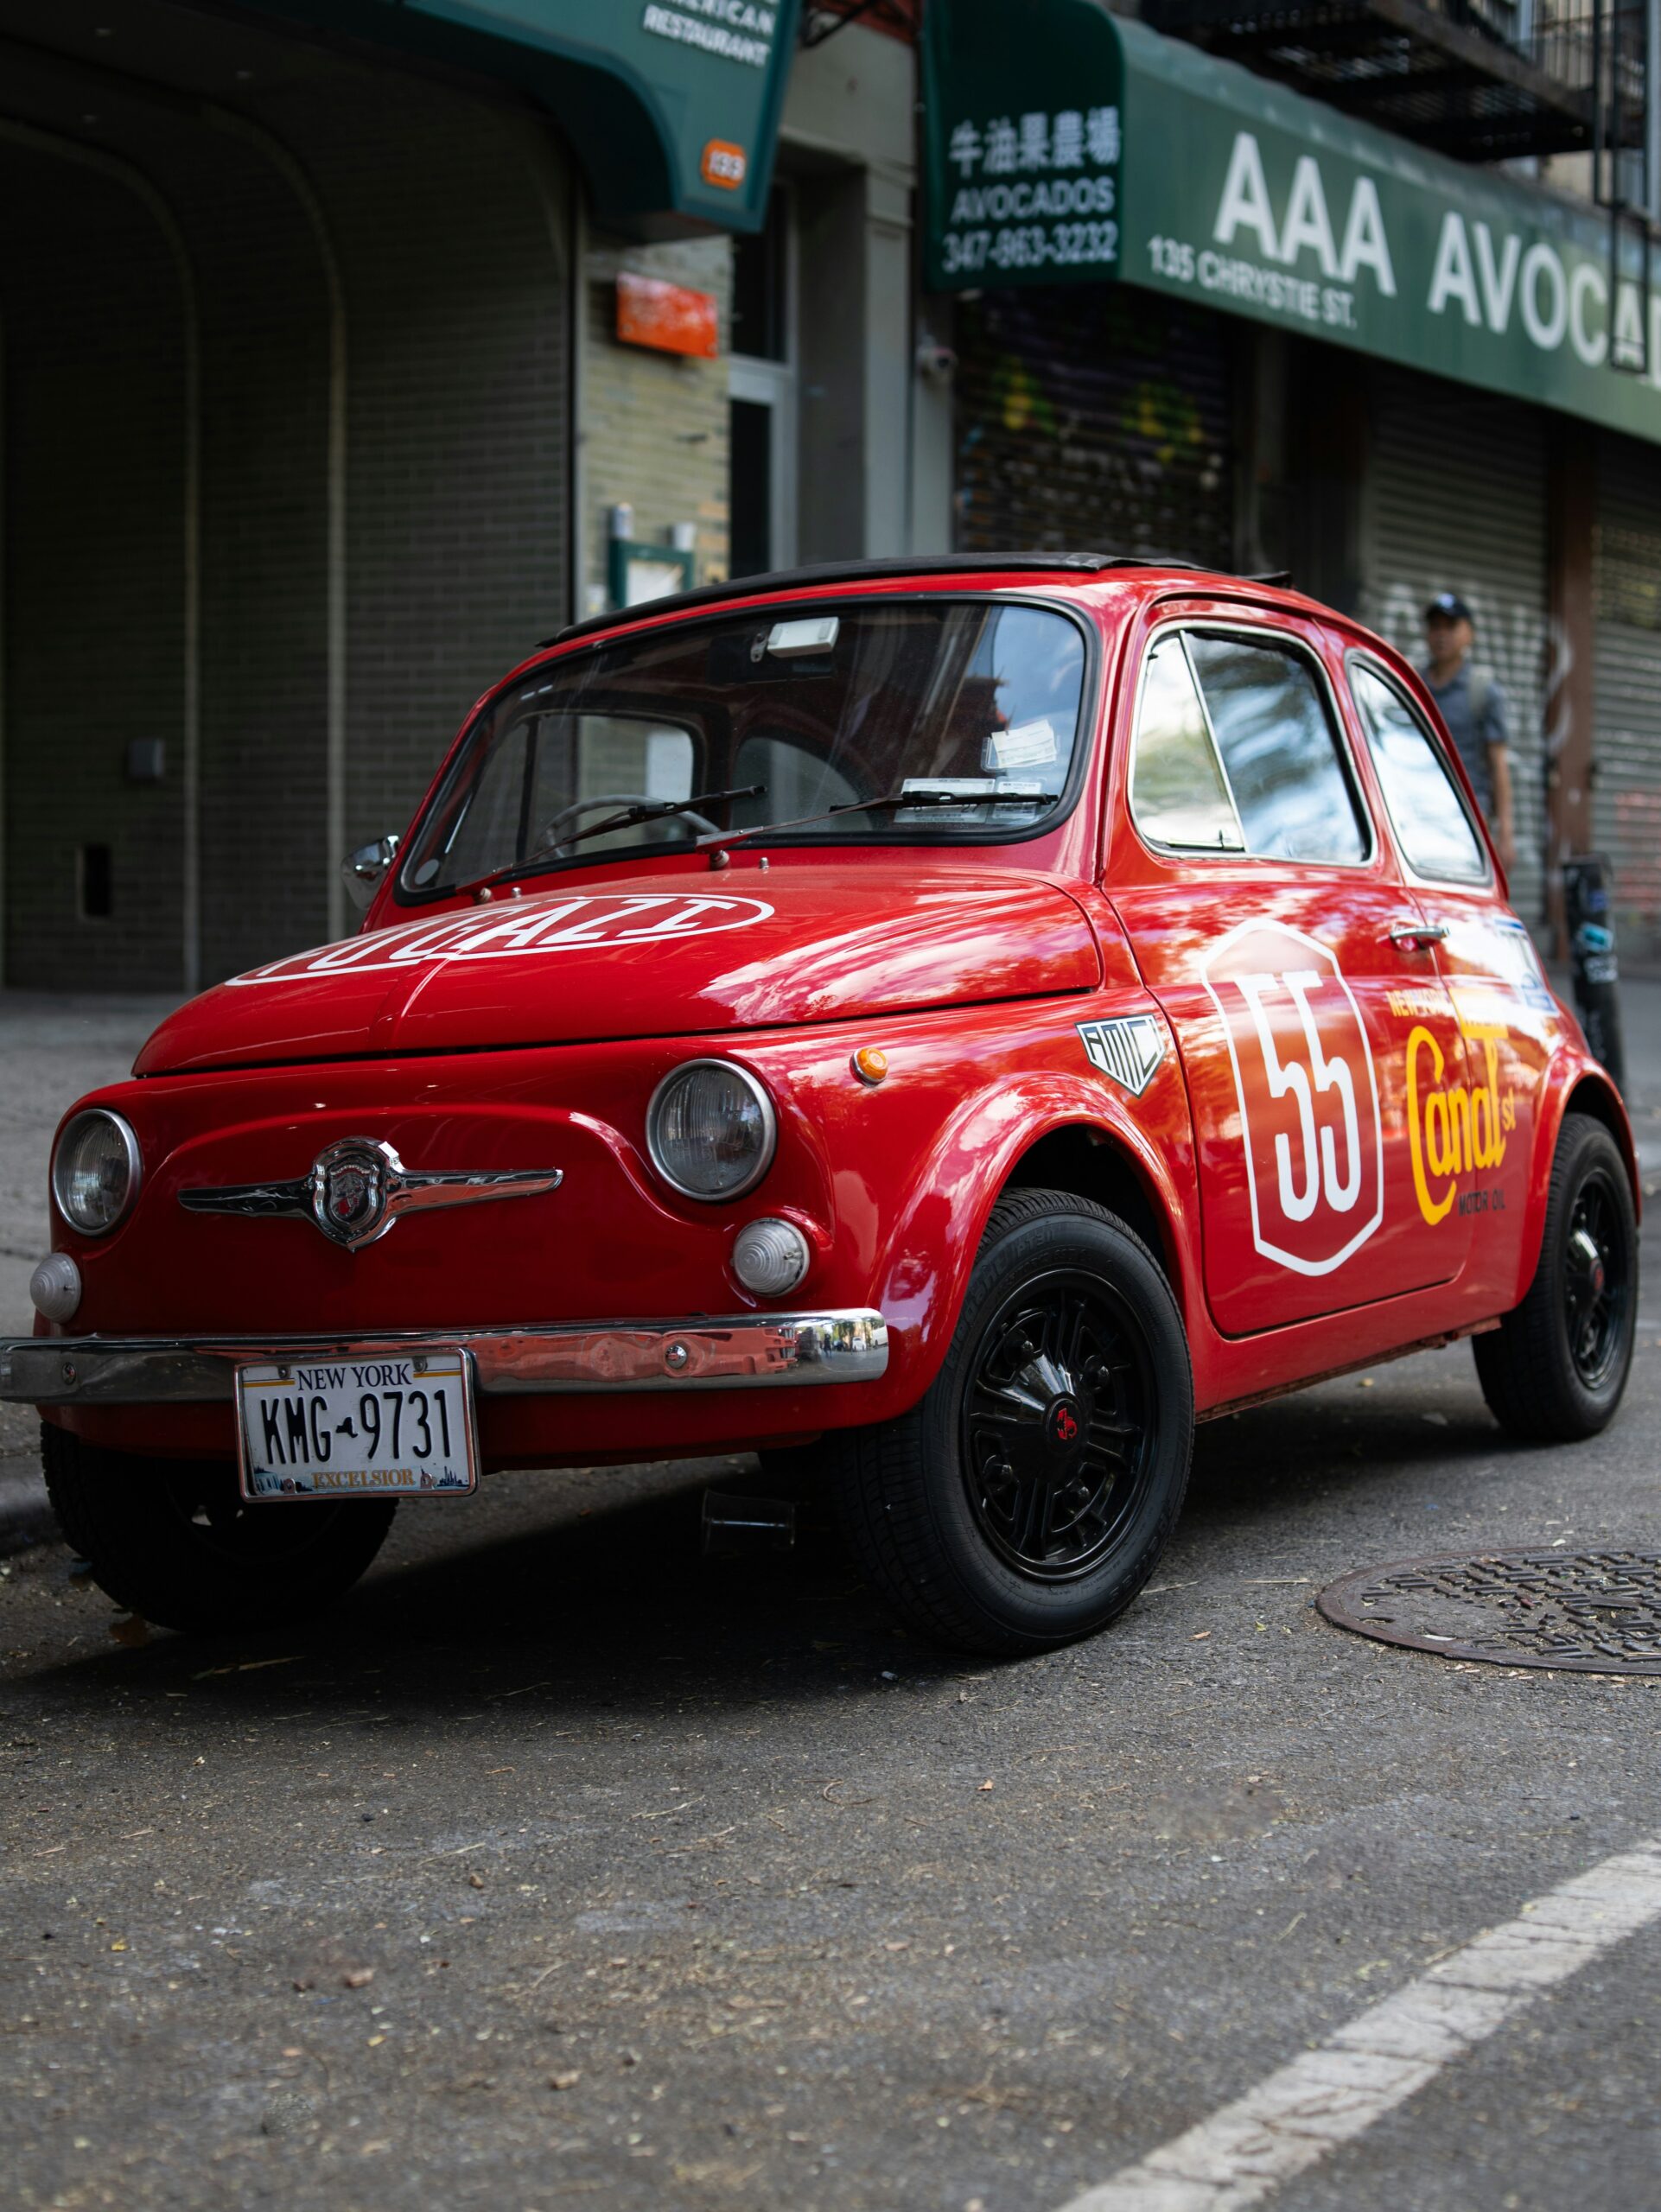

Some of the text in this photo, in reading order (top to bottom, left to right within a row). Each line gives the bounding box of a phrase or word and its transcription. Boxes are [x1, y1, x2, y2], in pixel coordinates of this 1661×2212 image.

[643, 4, 771, 67] RESTAURANT
[949, 106, 1121, 179] 牛油果農場
[951, 175, 1116, 224] AVOCADOS
[1213, 131, 1397, 297] AAA
[1148, 234, 1358, 330] 135 CHRYSTIE ST.
[256, 897, 736, 977] FUGAZI
[1385, 989, 1419, 1017] NEW
[1234, 969, 1362, 1223] 55
[1457, 1189, 1505, 1217] MOTOR OIL
[296, 1363, 413, 1391] NEW YORK
[311, 1468, 415, 1489] EXCELSIOR
